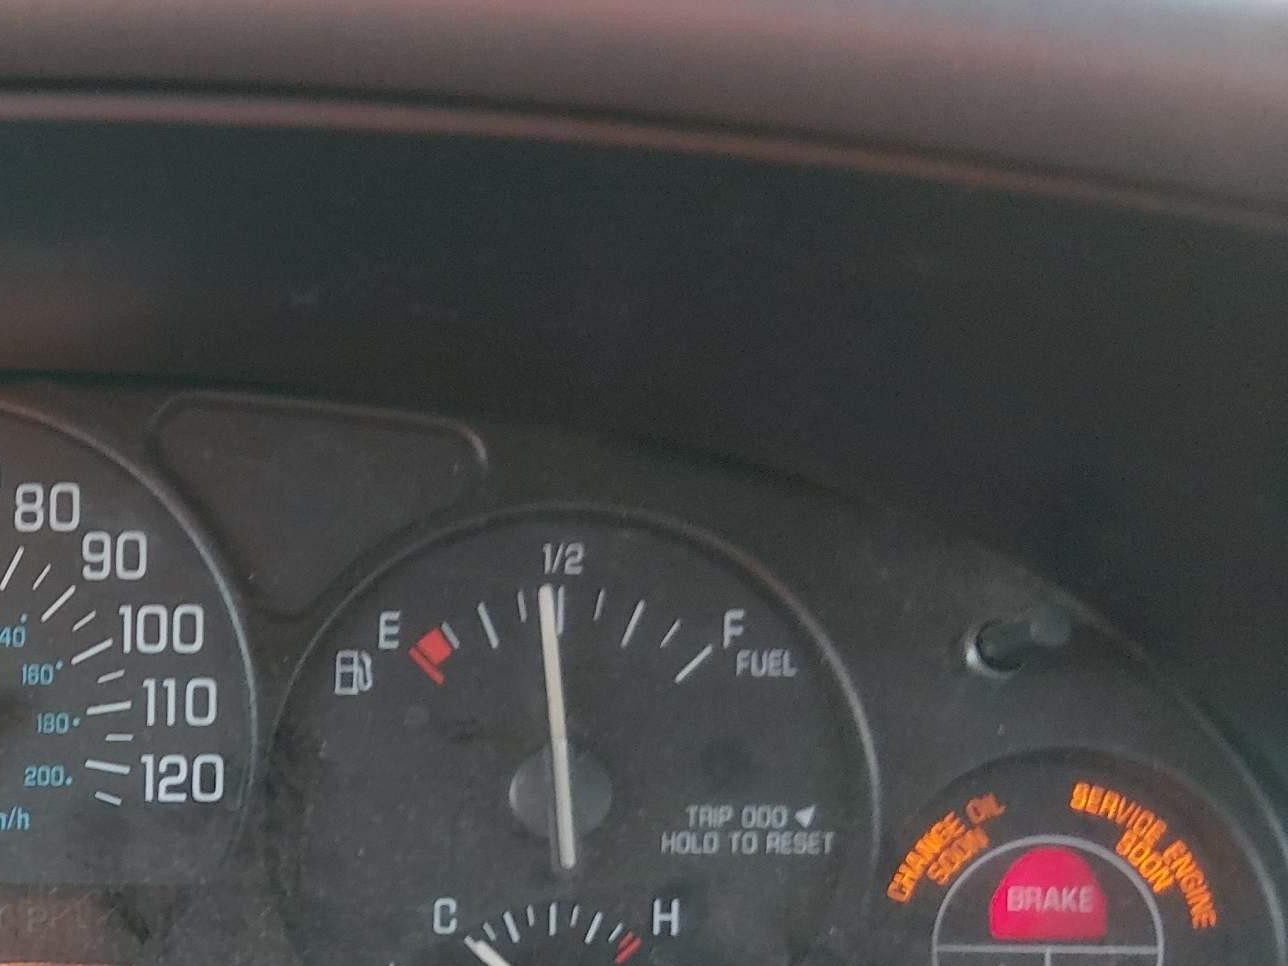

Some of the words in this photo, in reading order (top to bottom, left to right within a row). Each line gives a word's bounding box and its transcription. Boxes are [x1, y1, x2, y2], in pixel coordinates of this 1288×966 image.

[15, 483, 80, 532] 80
[82, 531, 147, 580] 90
[542, 543, 585, 575] 1/2
[120, 605, 204, 653] 100
[379, 611, 400, 649] E
[723, 609, 744, 648] F
[21, 665, 53, 685] 160
[735, 652, 797, 677] FUEL
[143, 678, 217, 726] 110
[37, 713, 69, 734] 180
[24, 767, 64, 788] 200
[140, 755, 224, 803] 120
[685, 805, 733, 828] TRIP
[660, 831, 720, 854] HOLD
[730, 831, 760, 854] TO
[765, 831, 834, 855] RESET
[887, 810, 967, 903] CHANGE
[1070, 781, 1168, 847] SERVICE
[1162, 839, 1217, 930] ENGINE
[1115, 829, 1176, 894] SOON
[433, 898, 457, 935] C
[1007, 885, 1095, 913] BRAKE
[653, 900, 679, 936] H
